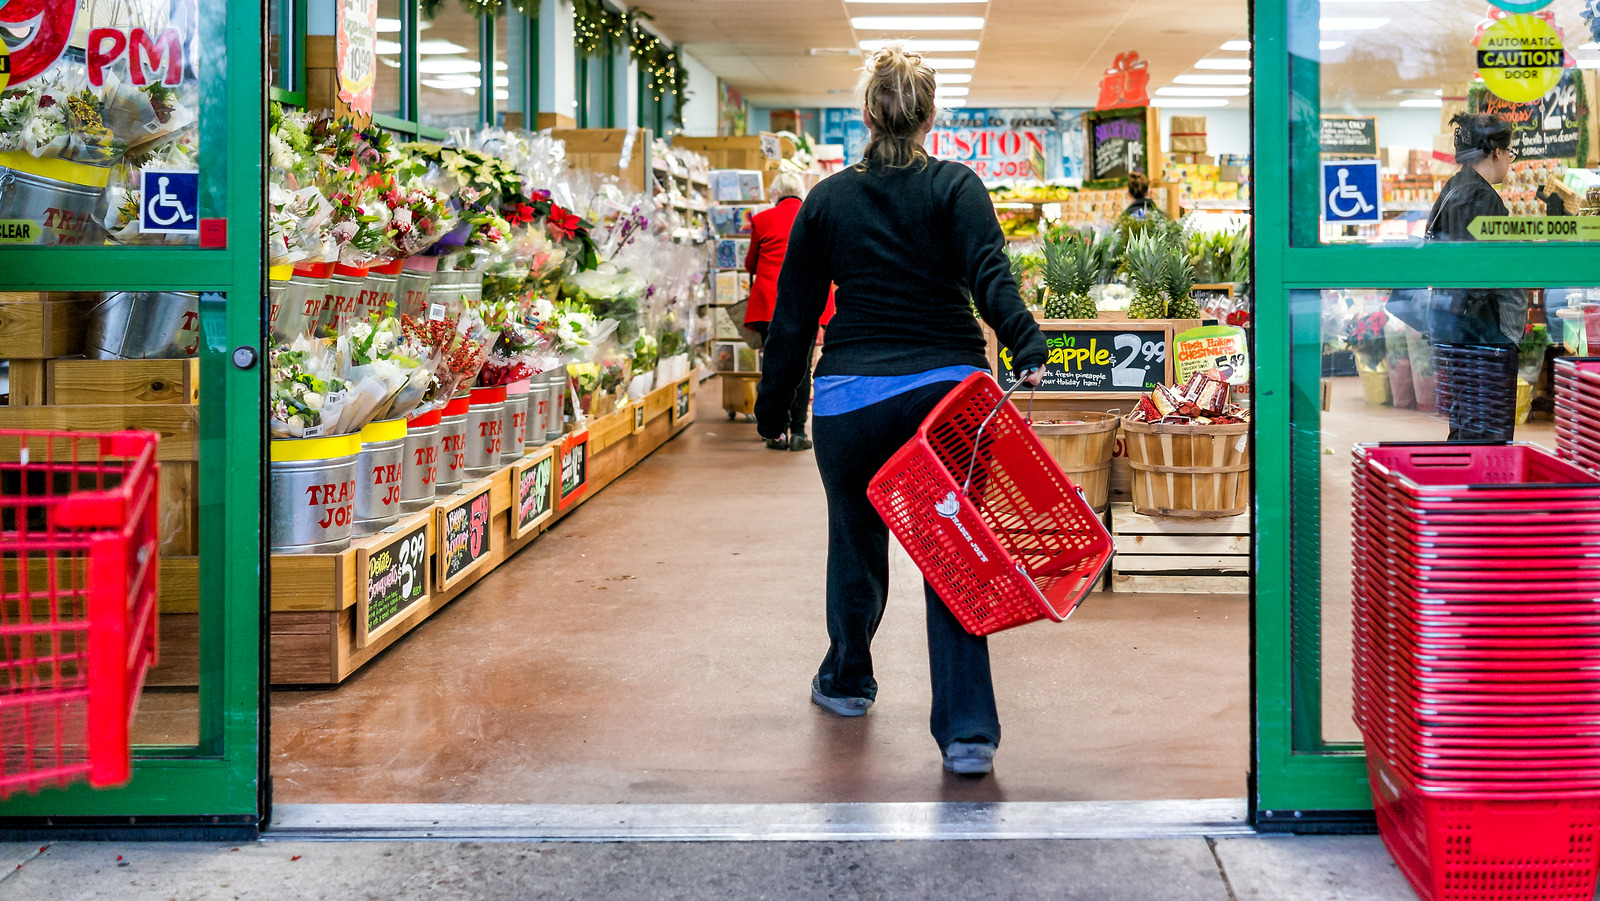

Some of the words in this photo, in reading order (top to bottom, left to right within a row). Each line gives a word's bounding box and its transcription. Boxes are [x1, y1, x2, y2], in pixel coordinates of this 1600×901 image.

[1488, 37, 1555, 46] AUTOMATIC
[86, 27, 183, 88] PM
[1483, 51, 1559, 66] CAUTION
[1505, 70, 1538, 79] DOOR
[931, 130, 1047, 160] ESTON
[0, 224, 30, 239] LEAR
[1481, 221, 1543, 235] AUTOMATIC
[1547, 221, 1577, 235] DOOR
[1047, 334, 1075, 347] esh
[1180, 340, 1203, 351] Fresh
[1178, 346, 1237, 361] CHESTNUTS
[1055, 370, 1074, 378] fresh
[1075, 372, 1107, 381] pineapple
[1041, 379, 1056, 387] your
[1083, 379, 1101, 387] ham!
[369, 550, 392, 578] Petite
[368, 563, 398, 603] Bouquets
